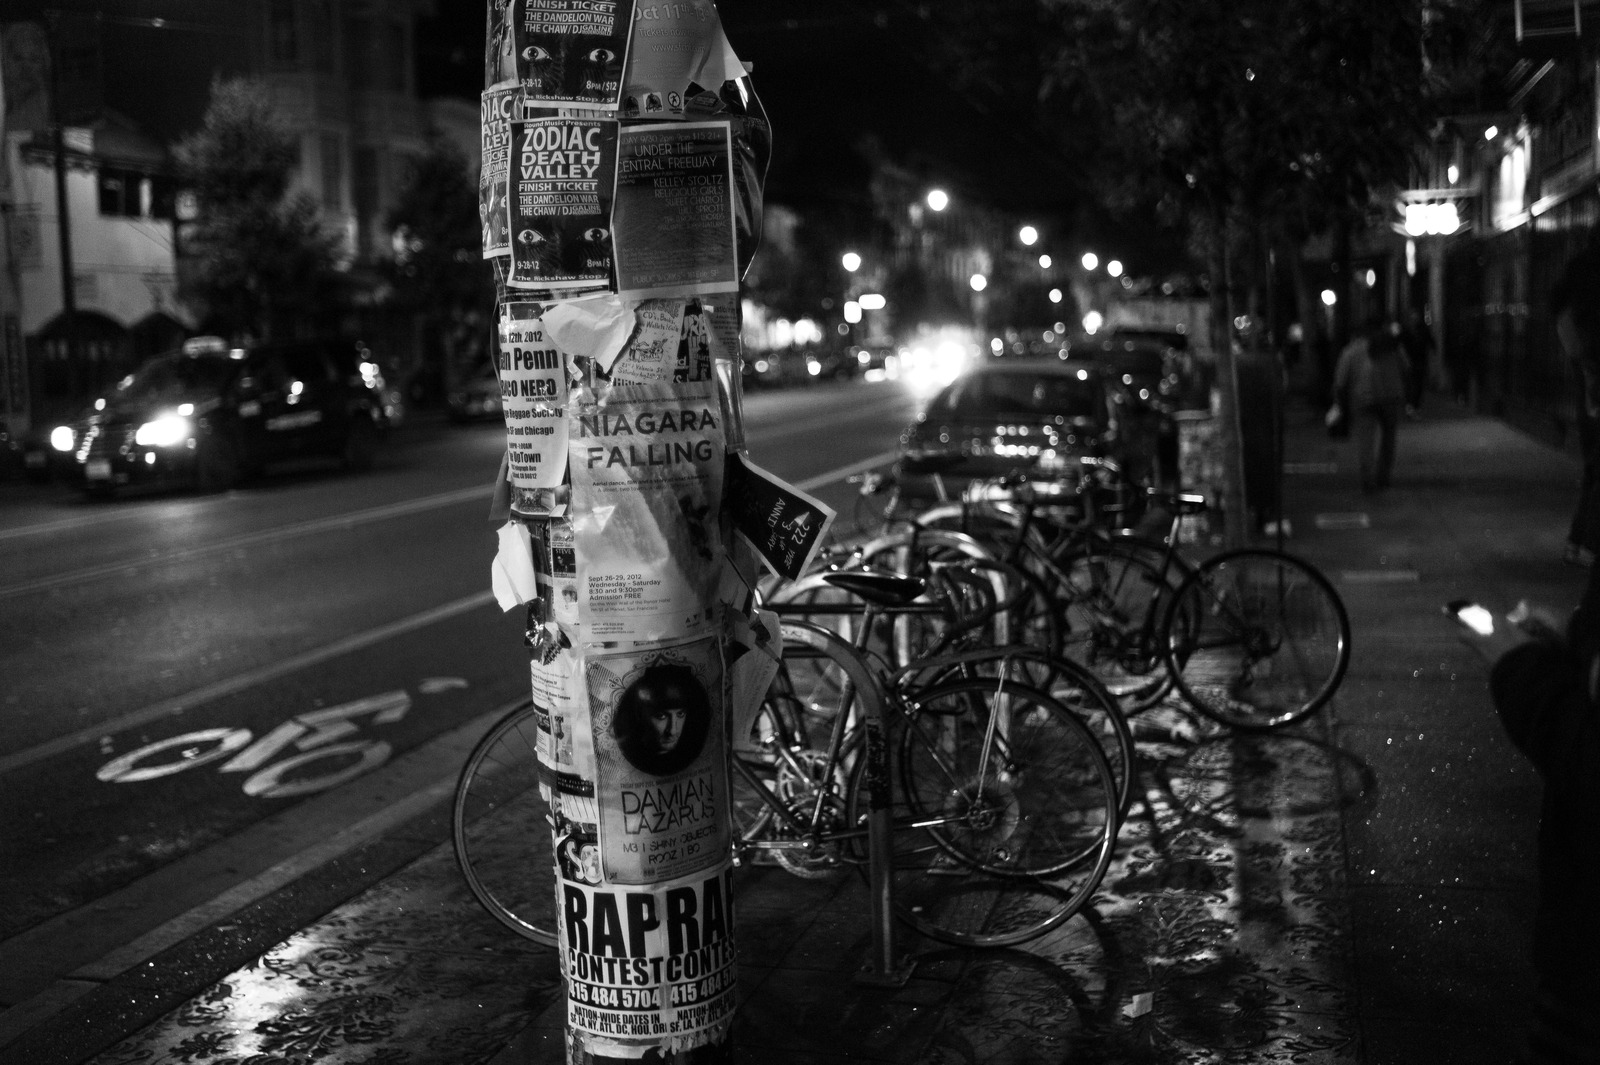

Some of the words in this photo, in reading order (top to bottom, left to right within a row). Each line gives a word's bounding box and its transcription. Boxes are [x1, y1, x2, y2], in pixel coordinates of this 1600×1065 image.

[526, 0, 567, 9] FINISH
[571, 1, 616, 13] TICKET
[525, 12, 542, 21] THE
[543, 12, 592, 22] DANDELION
[593, 15, 615, 25] WAR
[525, 24, 541, 33] THE
[606, 81, 617, 91] $12
[522, 126, 601, 152] ZODIAC
[634, 143, 672, 157] UNDER
[676, 142, 694, 154] THE
[521, 151, 601, 166] DEATH
[668, 155, 717, 169] FREEWAY
[520, 165, 599, 179] VALLEY
[519, 182, 552, 192] FINISH
[556, 182, 598, 191] TICKET
[653, 177, 685, 188] KELLEY
[687, 174, 723, 185] STOLTZ
[654, 188, 697, 198] RELIGIOUS
[699, 186, 724, 195] GIRLS
[519, 195, 532, 205] THE
[533, 195, 580, 205] DANDELION
[580, 195, 599, 204] WAR
[519, 206, 533, 216] THE
[533, 206, 555, 216] CHAW
[517, 260, 539, 270] 9-28-12
[524, 331, 543, 343] 2012
[513, 347, 559, 370] Penn
[520, 378, 557, 397] NERO
[579, 408, 717, 438] NIAGARA
[524, 426, 554, 436] Chicago
[587, 440, 713, 469] FALLING
[781, 520, 792, 531] 3
[791, 523, 810, 545] 222
[621, 774, 714, 815] DAMIAN
[624, 797, 715, 836] LAZARUS
[623, 842, 638, 853] M3
[649, 838, 677, 853] SHINY
[680, 823, 717, 844] OBJECTS
[649, 850, 678, 865] ROOZ
[687, 843, 701, 856] BO
[563, 884, 661, 958] RAP
[569, 947, 664, 986] CONTEST
[591, 987, 619, 1008] 484
[622, 989, 661, 1008] 5704
[669, 983, 698, 1005] 415
[700, 975, 722, 998] 484
[574, 1005, 621, 1025] NATION-WIDE
[622, 1014, 649, 1025] DATES
[650, 1013, 660, 1024] IN
[631, 1024, 652, 1036] HOU,
